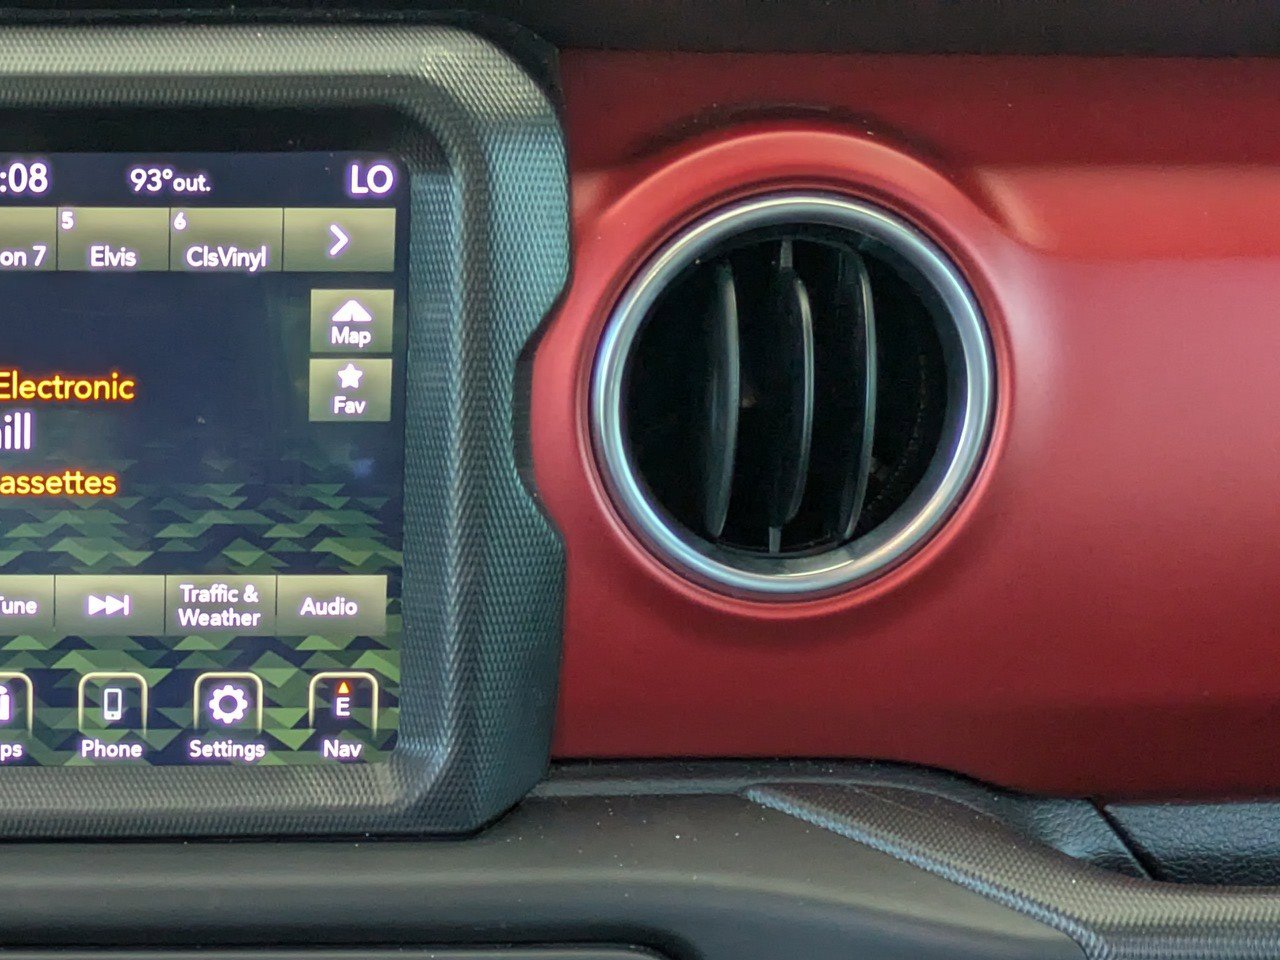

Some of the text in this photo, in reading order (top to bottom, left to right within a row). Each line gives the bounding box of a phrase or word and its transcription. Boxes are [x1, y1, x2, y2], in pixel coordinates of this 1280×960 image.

[350, 164, 394, 194] LO
[61, 211, 74, 230] 5
[173, 212, 187, 231] 6
[0, 250, 27, 266] on
[32, 246, 47, 266] 7
[90, 246, 137, 267] Elvis
[186, 246, 267, 272] ClsVinyl
[331, 327, 371, 347] Map
[333, 397, 366, 415] Fav
[180, 584, 259, 603] Traffic &
[300, 596, 358, 616] Audio
[178, 607, 261, 627] Weather
[335, 697, 350, 717] E
[81, 739, 143, 758] Phone
[189, 739, 266, 763] Settings
[323, 740, 362, 758] Nav
